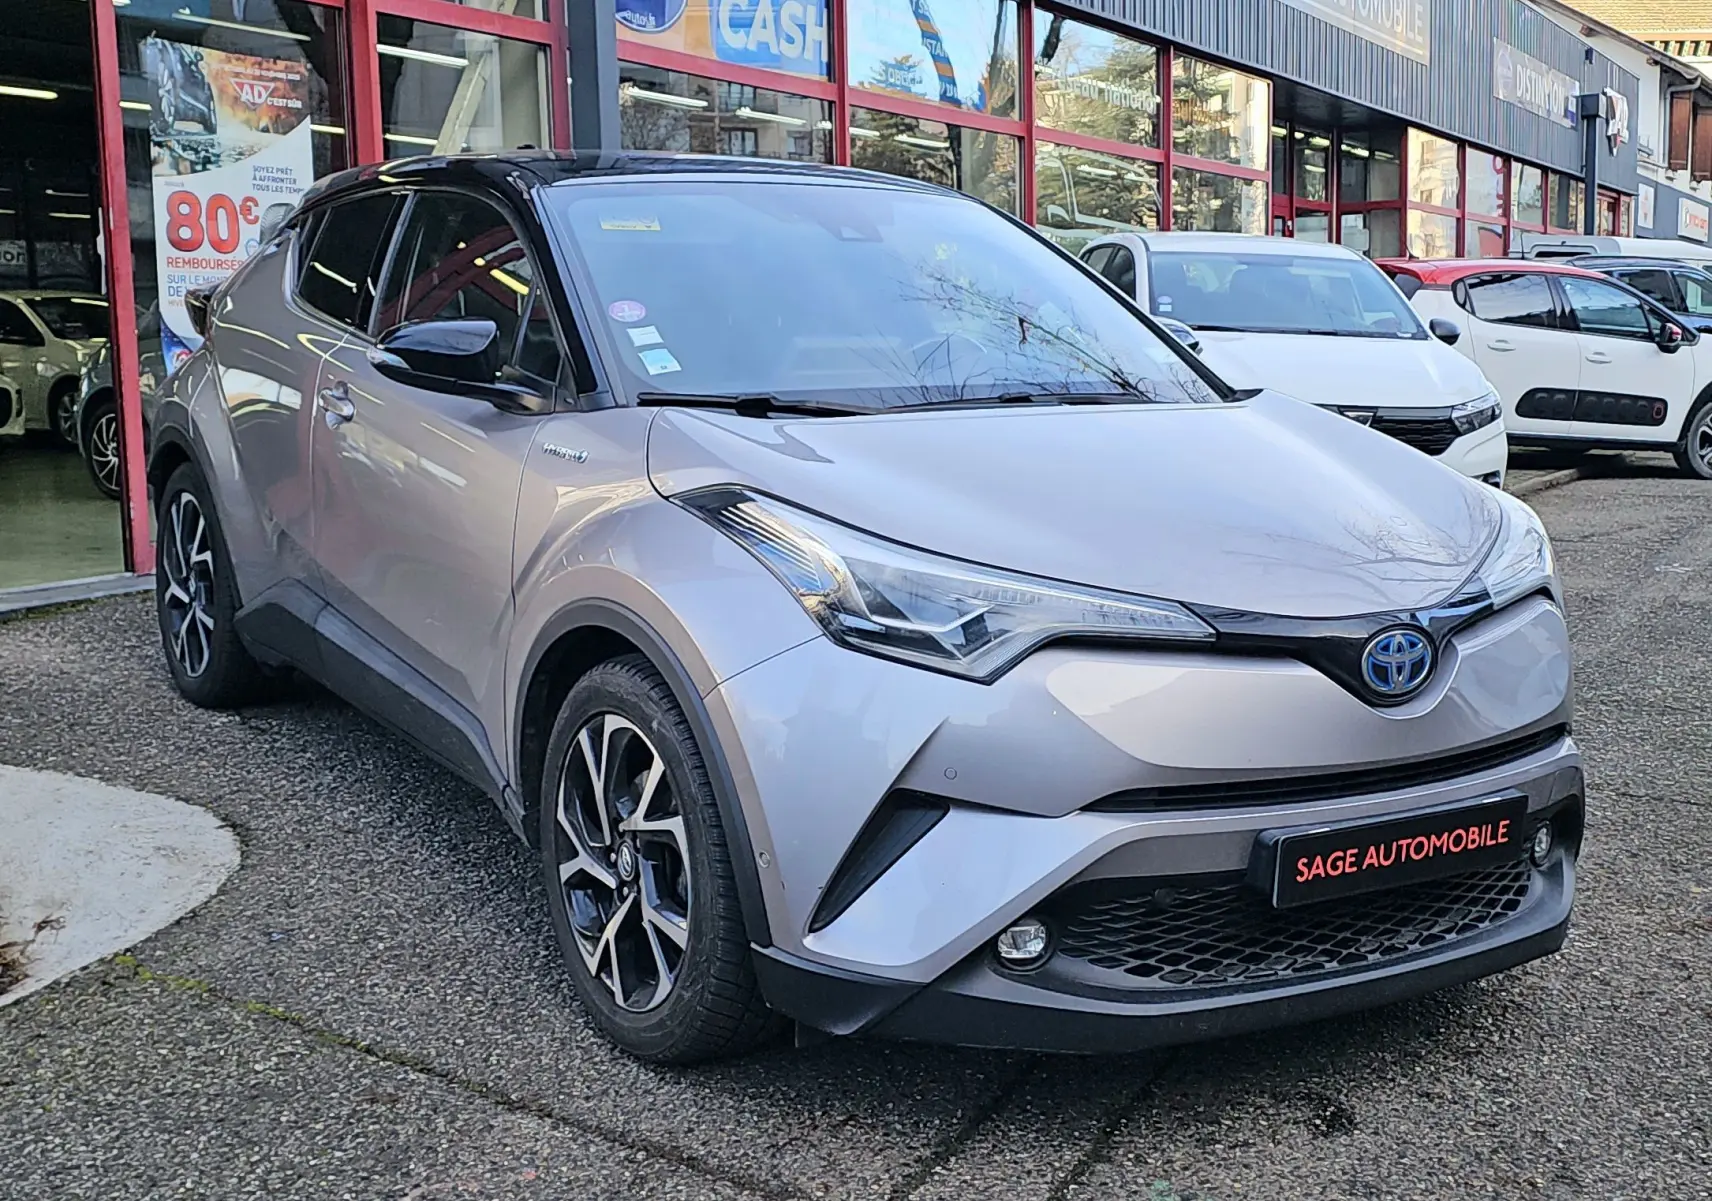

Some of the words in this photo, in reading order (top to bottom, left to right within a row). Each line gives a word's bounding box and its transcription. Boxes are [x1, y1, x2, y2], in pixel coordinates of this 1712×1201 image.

[1333, 0, 1424, 42] MOBILE
[718, 0, 829, 62] CASH
[240, 83, 267, 104] AD
[252, 165, 275, 175] SOYEZ
[275, 166, 293, 176] PRÊT
[252, 183, 272, 193] TOUS
[272, 185, 285, 193] LES
[258, 175, 297, 186] AFFRONTER
[166, 190, 260, 255] 80€
[167, 274, 187, 285] SUR
[188, 276, 200, 286] LE
[168, 285, 183, 298] DE
[1295, 848, 1358, 883] SAGE
[1361, 819, 1510, 870] AUTOMOBILE
